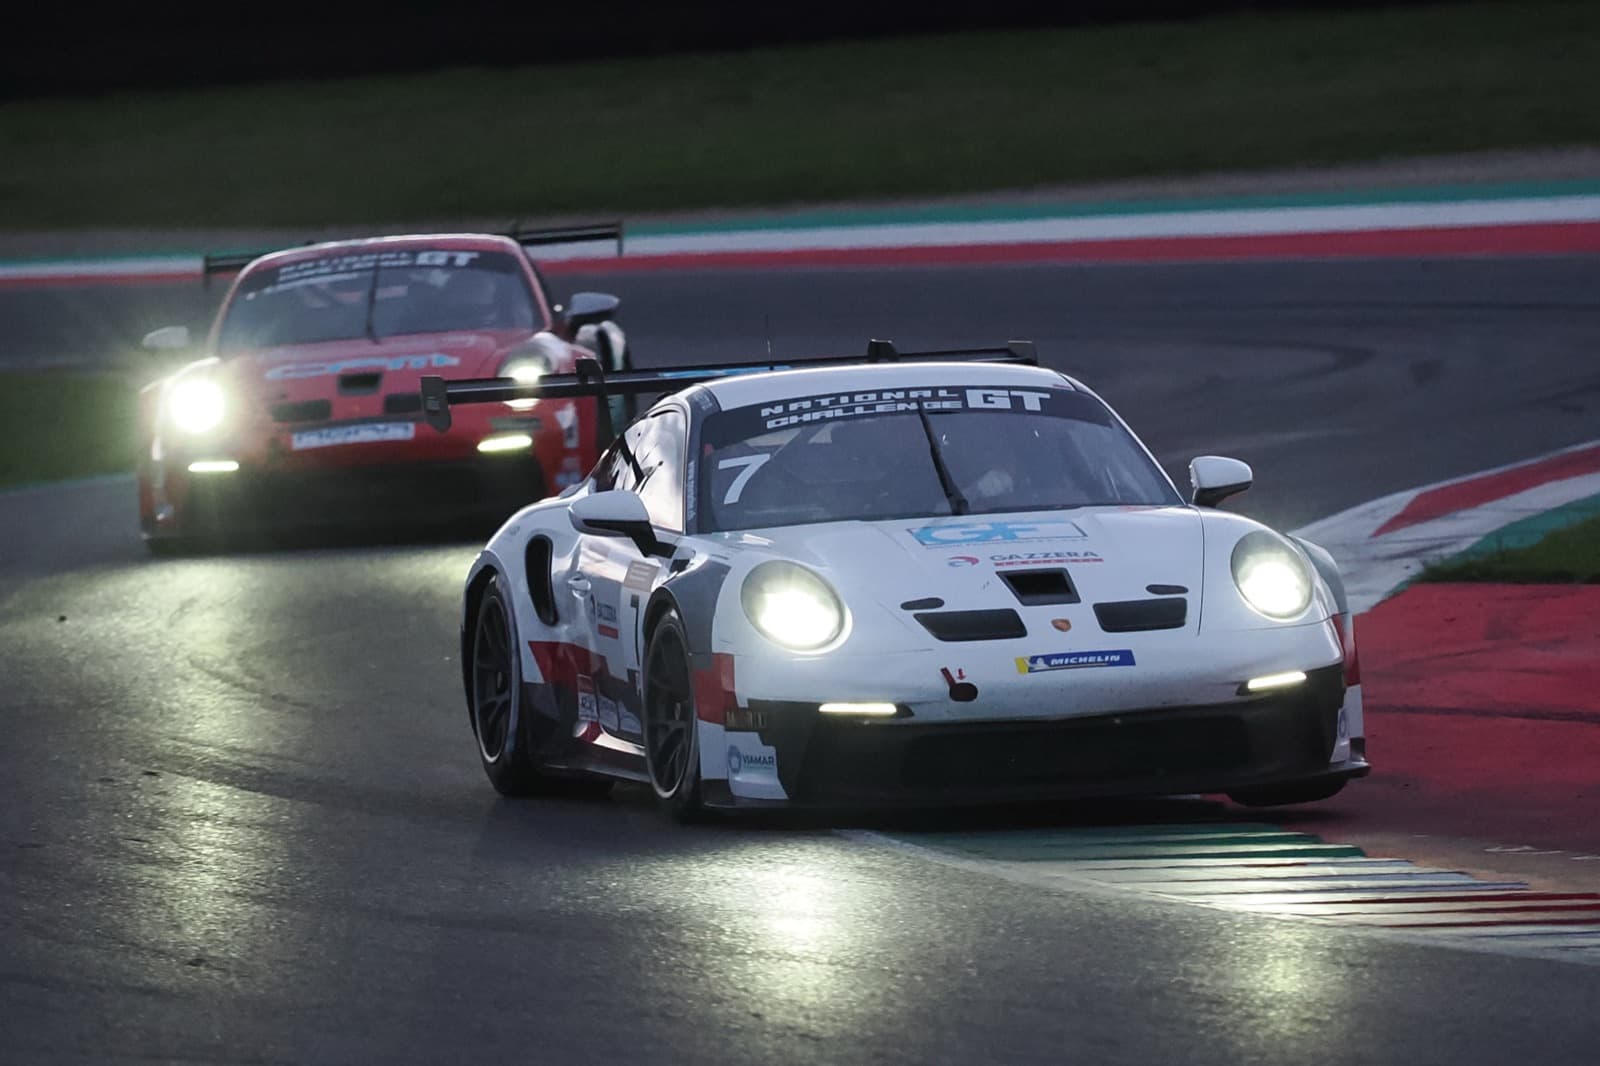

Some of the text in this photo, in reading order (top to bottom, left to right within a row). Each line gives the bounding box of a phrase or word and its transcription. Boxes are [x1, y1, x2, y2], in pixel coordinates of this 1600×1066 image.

[761, 388, 960, 417] NATIONAL
[766, 389, 1051, 430] CHALLENGE GT
[718, 453, 771, 505] 7
[989, 551, 1099, 562] GAZZERA
[1050, 654, 1120, 665] MICHELIN
